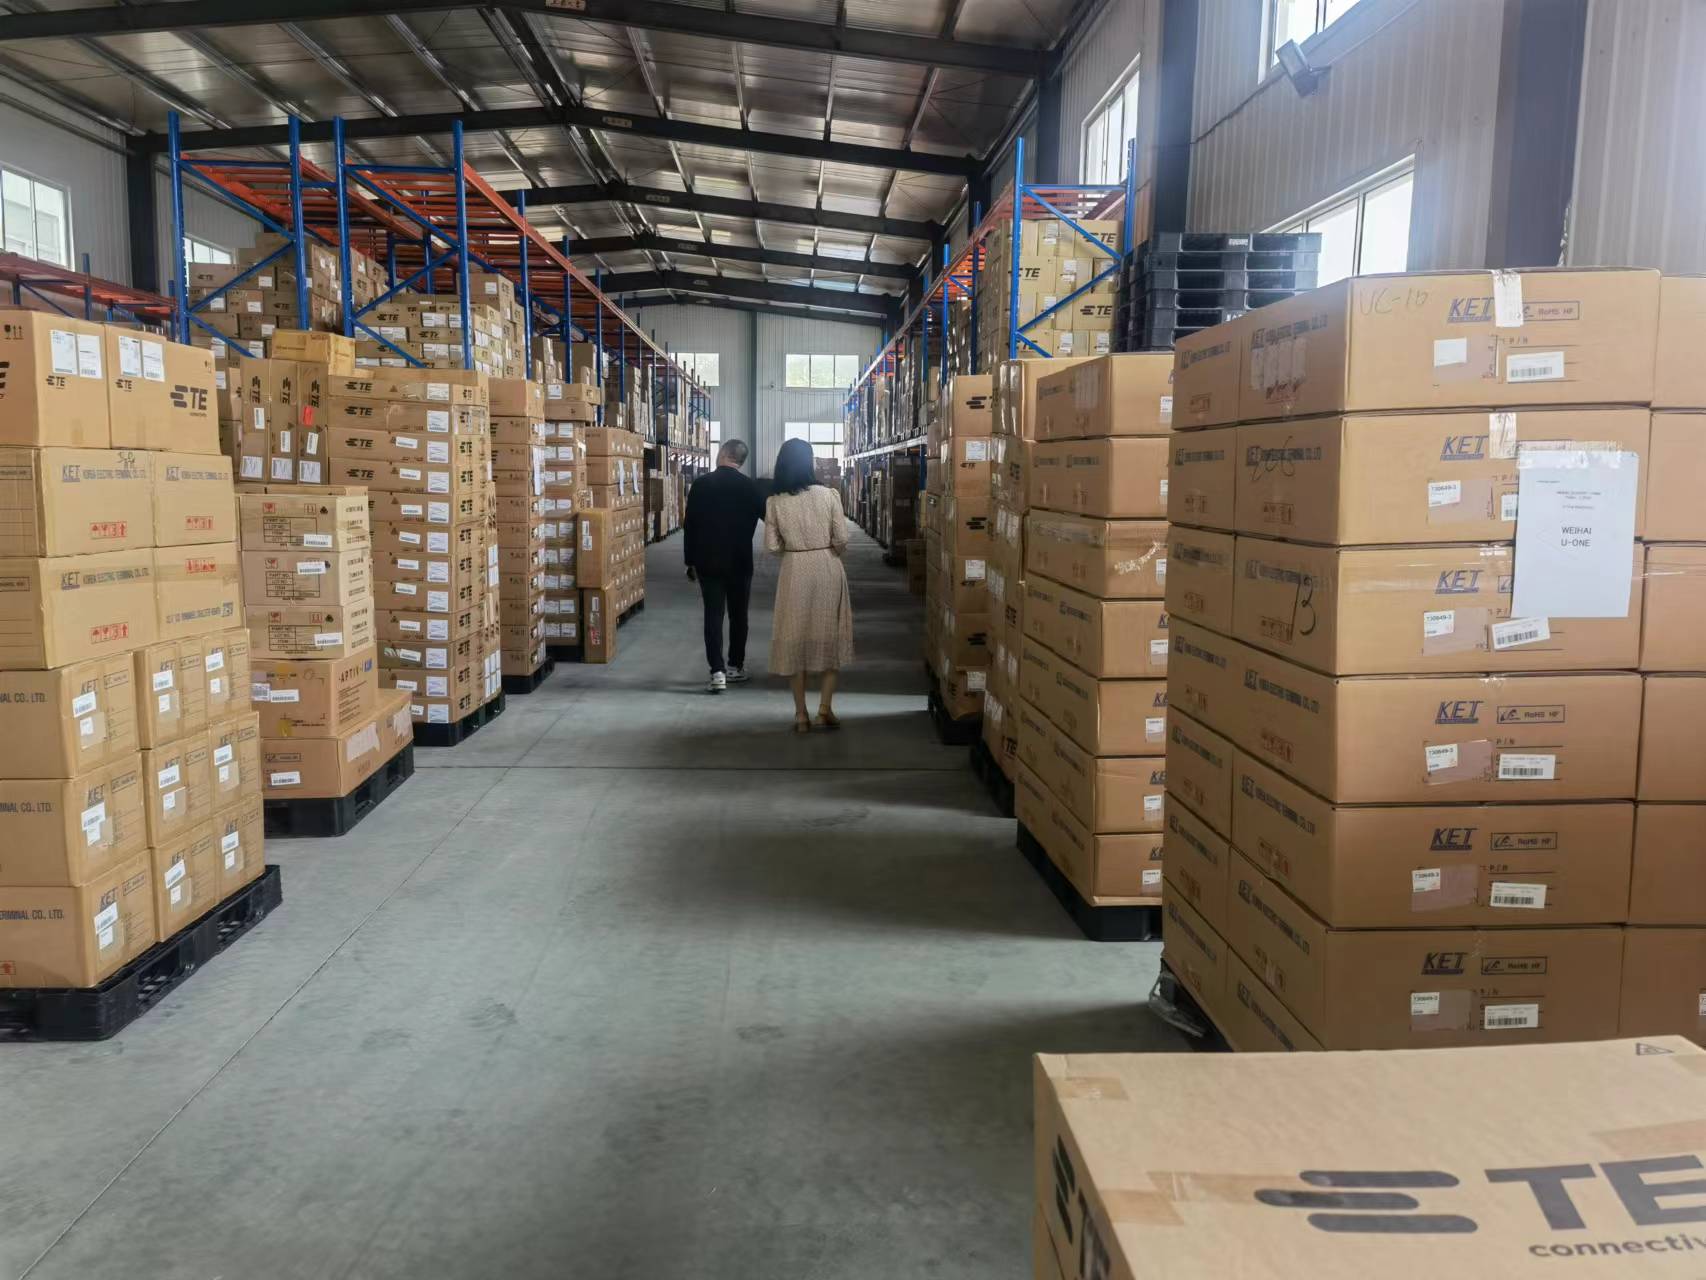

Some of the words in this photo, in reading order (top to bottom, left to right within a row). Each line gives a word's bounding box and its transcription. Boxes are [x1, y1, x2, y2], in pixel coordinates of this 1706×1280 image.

[1449, 297, 1495, 318] KET
[1442, 435, 1489, 455] KET
[1561, 527, 1592, 535] WEIHAI
[1560, 539, 1591, 547] U-ONE
[1436, 570, 1483, 589] KET
[1436, 701, 1483, 719] KET
[1431, 828, 1477, 846] KET
[1423, 952, 1467, 970] KET
[1484, 1154, 1706, 1230] TE
